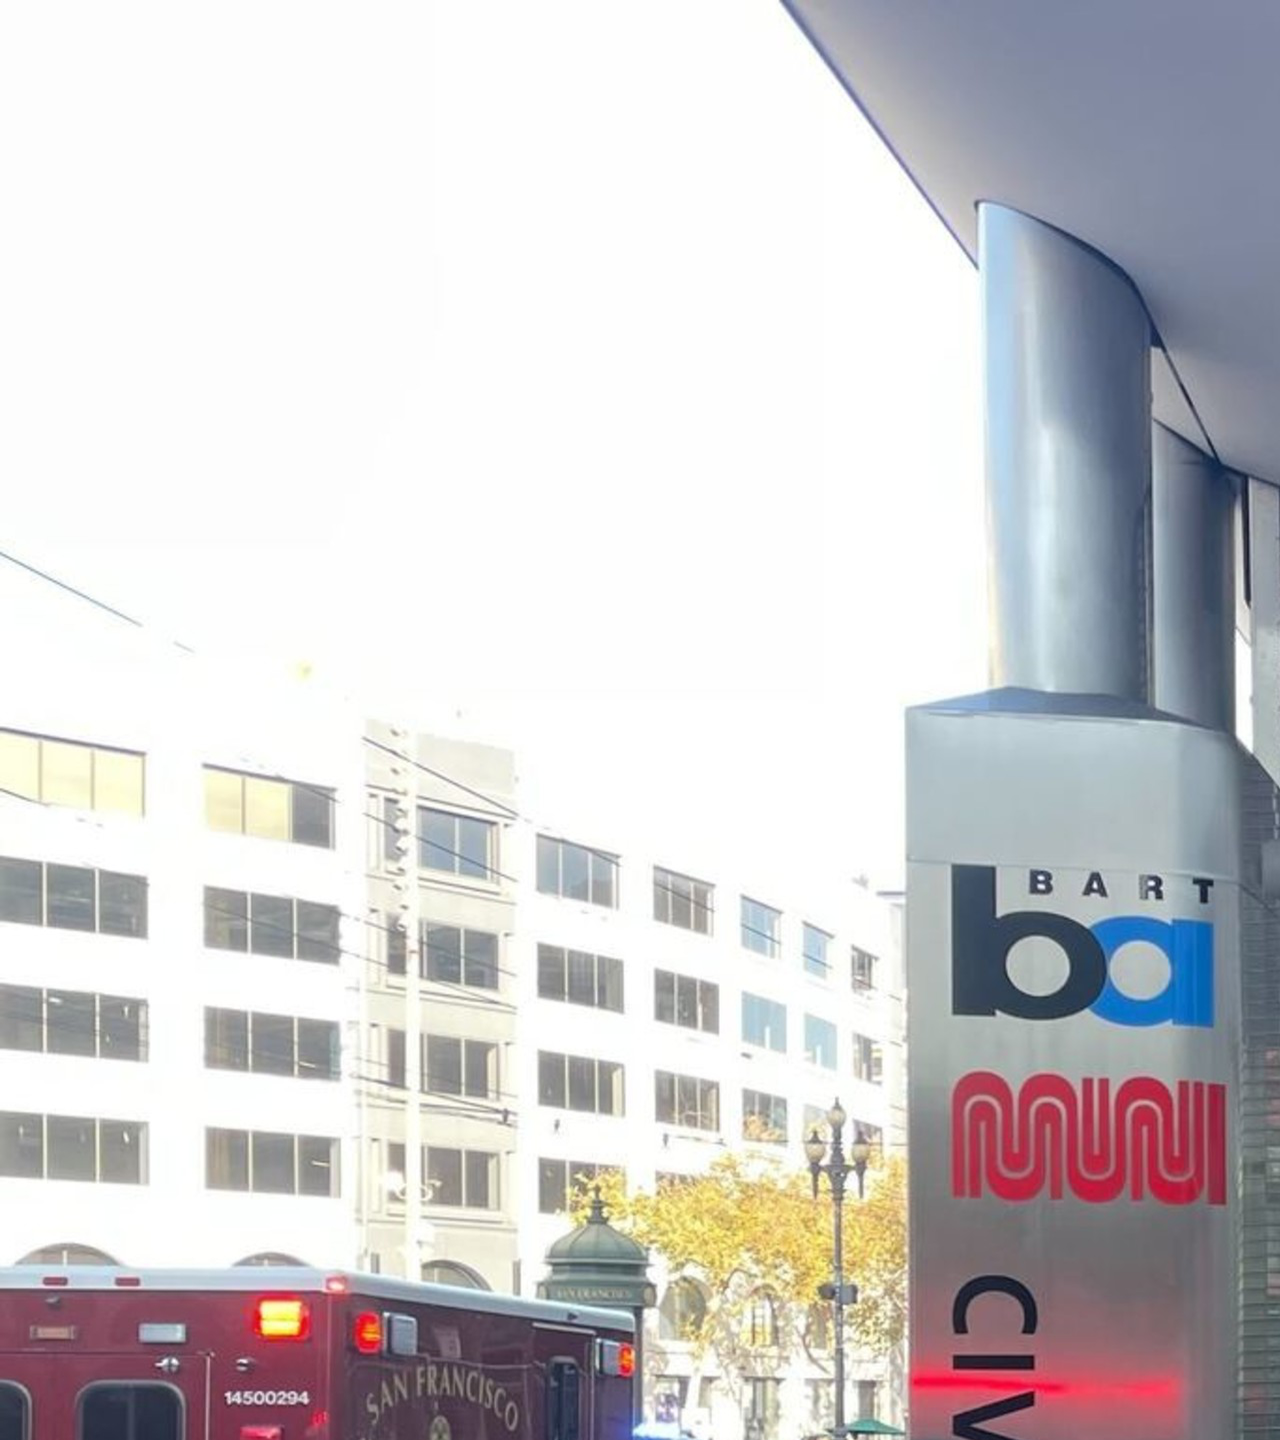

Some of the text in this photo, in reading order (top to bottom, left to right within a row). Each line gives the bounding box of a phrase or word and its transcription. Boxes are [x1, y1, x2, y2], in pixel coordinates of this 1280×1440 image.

[1029, 869, 1214, 905] BART
[224, 1390, 310, 1406] 14500294
[366, 1363, 519, 1432] SAN FRANCISCO
